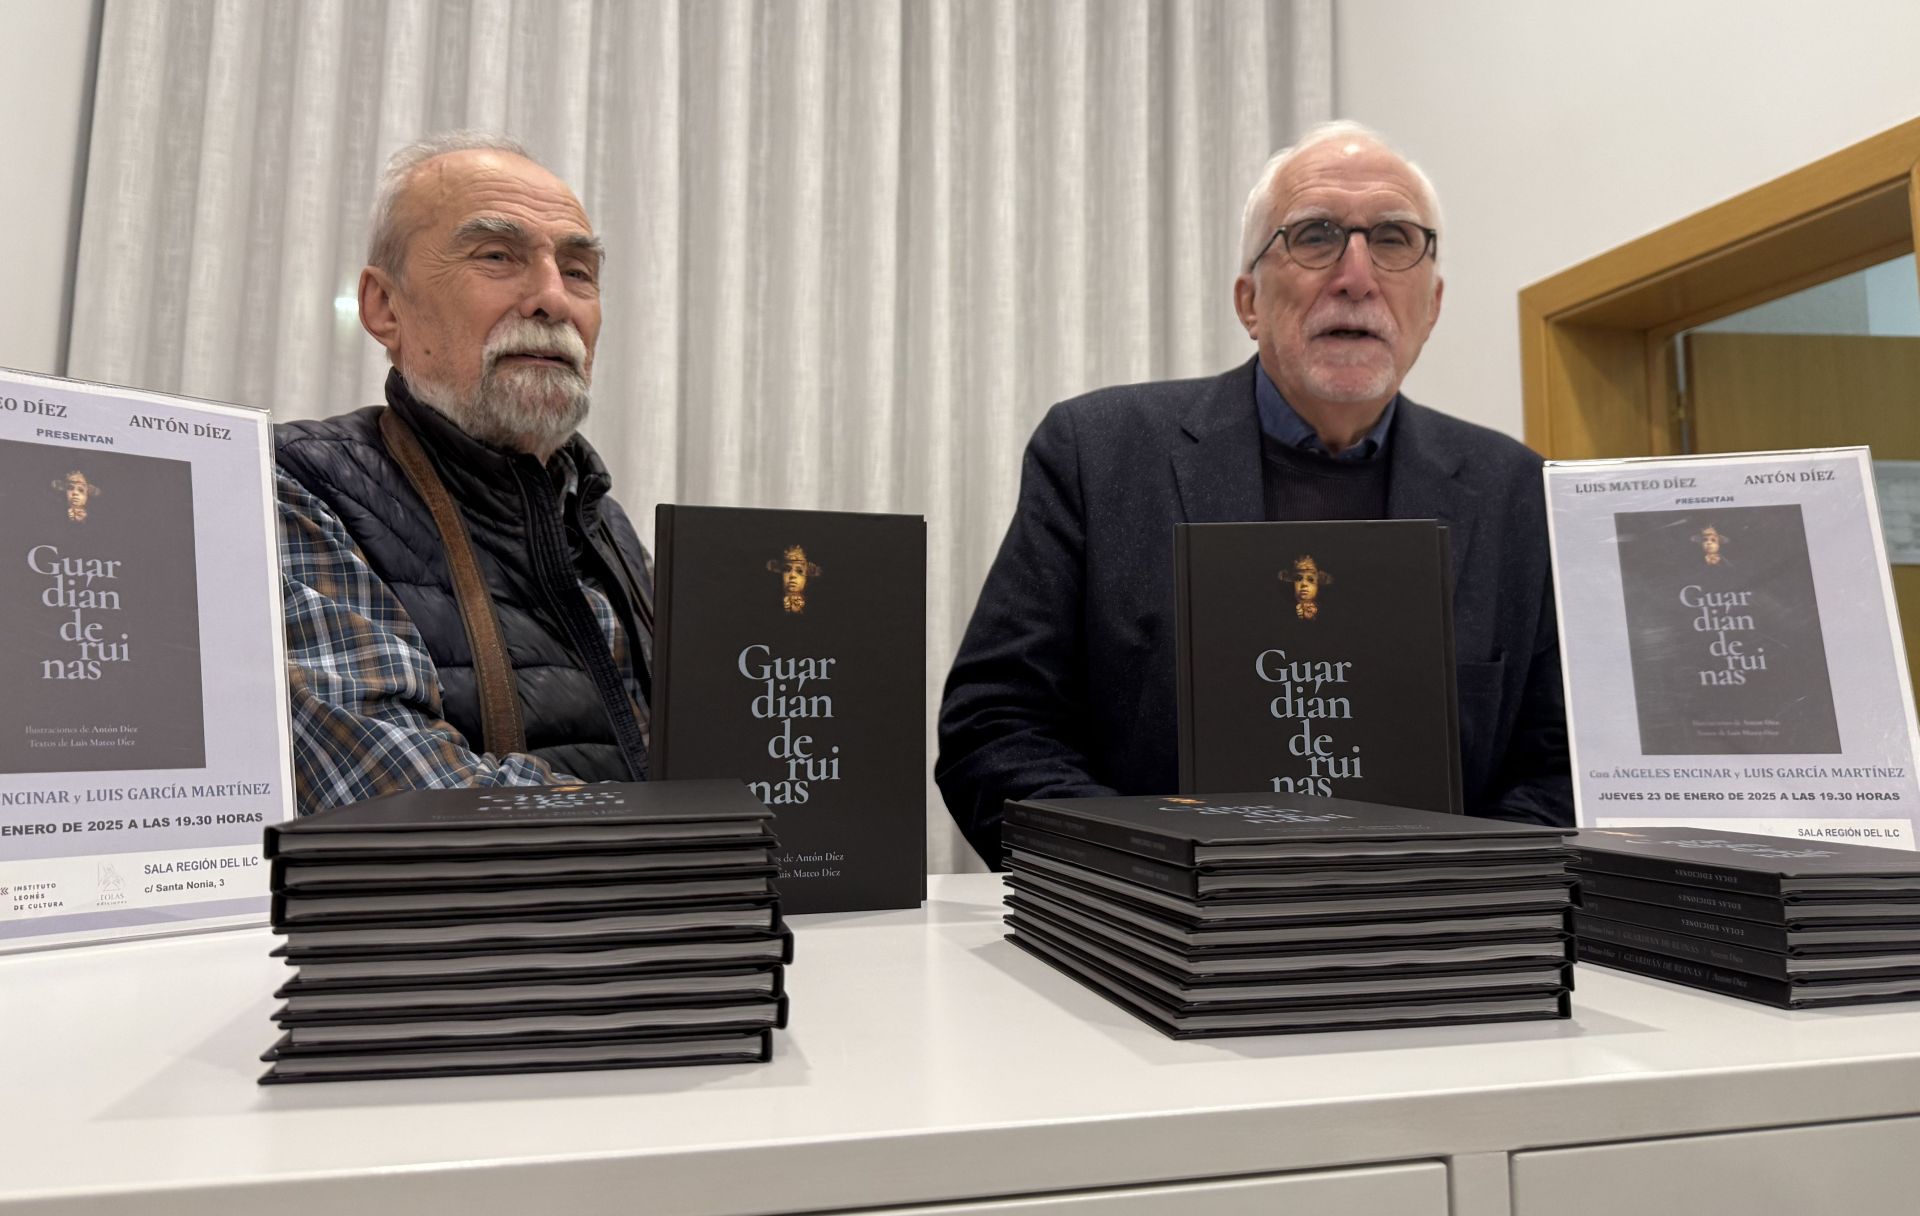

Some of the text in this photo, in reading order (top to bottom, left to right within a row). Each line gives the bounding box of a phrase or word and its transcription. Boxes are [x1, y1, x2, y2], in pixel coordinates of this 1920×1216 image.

[23, 399, 67, 418] DÍEZ
[129, 411, 232, 440] ANTÓN DÍEZ
[37, 428, 114, 445] PRESENTAN
[1575, 475, 1697, 494] LUIS MATEO DÍEZ
[1744, 468, 1835, 485] ANTÓN DÍEZ
[1675, 496, 1734, 505] PRESENTAN
[27, 545, 122, 579] Guar
[1679, 585, 1751, 608] Guar
[60, 609, 103, 642] de
[80, 633, 130, 661] rui
[1709, 631, 1743, 657] de
[41, 659, 102, 680] nas
[738, 644, 836, 680] Guar
[1255, 649, 1352, 683] Guar
[1726, 648, 1767, 671] rui
[1699, 668, 1746, 686] nas
[70, 738, 88, 747] Luis
[768, 718, 813, 758] de
[1289, 718, 1333, 757] de
[785, 746, 841, 781] rui
[1307, 746, 1363, 779] rui
[1613, 766, 1670, 778] ÁNGELES
[1674, 768, 1731, 778] ENCINAR
[1744, 768, 1773, 778] LUIS
[1777, 765, 1828, 778] GARCÍA
[1831, 765, 1905, 778] MARTÍNEZ
[74, 794, 81, 805] y
[86, 788, 123, 802] LUIS
[127, 783, 187, 800] GARCÍA
[191, 781, 271, 798] MARTÍNEZ
[746, 780, 809, 804] nas
[1270, 776, 1333, 798] nas
[1598, 791, 1901, 801] JUEVES 23 DE ENERO DE 2025 A LAS 19.30 HORAS
[1, 812, 263, 837] ENERO DE 2025 A LAS 19.30 HORAS
[1798, 827, 1900, 838] SALA REGIÓN DEL ILC
[144, 856, 258, 875] SALA REGIÓN DEL ILC
[795, 851, 823, 862] Antón
[793, 869, 820, 878] Mateo
[14, 882, 57, 892] INSTITUTO
[14, 891, 45, 901] LEONÉS
[156, 882, 184, 893] Santa
[186, 880, 217, 890] Nonia,
[219, 878, 225, 887] 3
[28, 901, 64, 910] CULTURA
